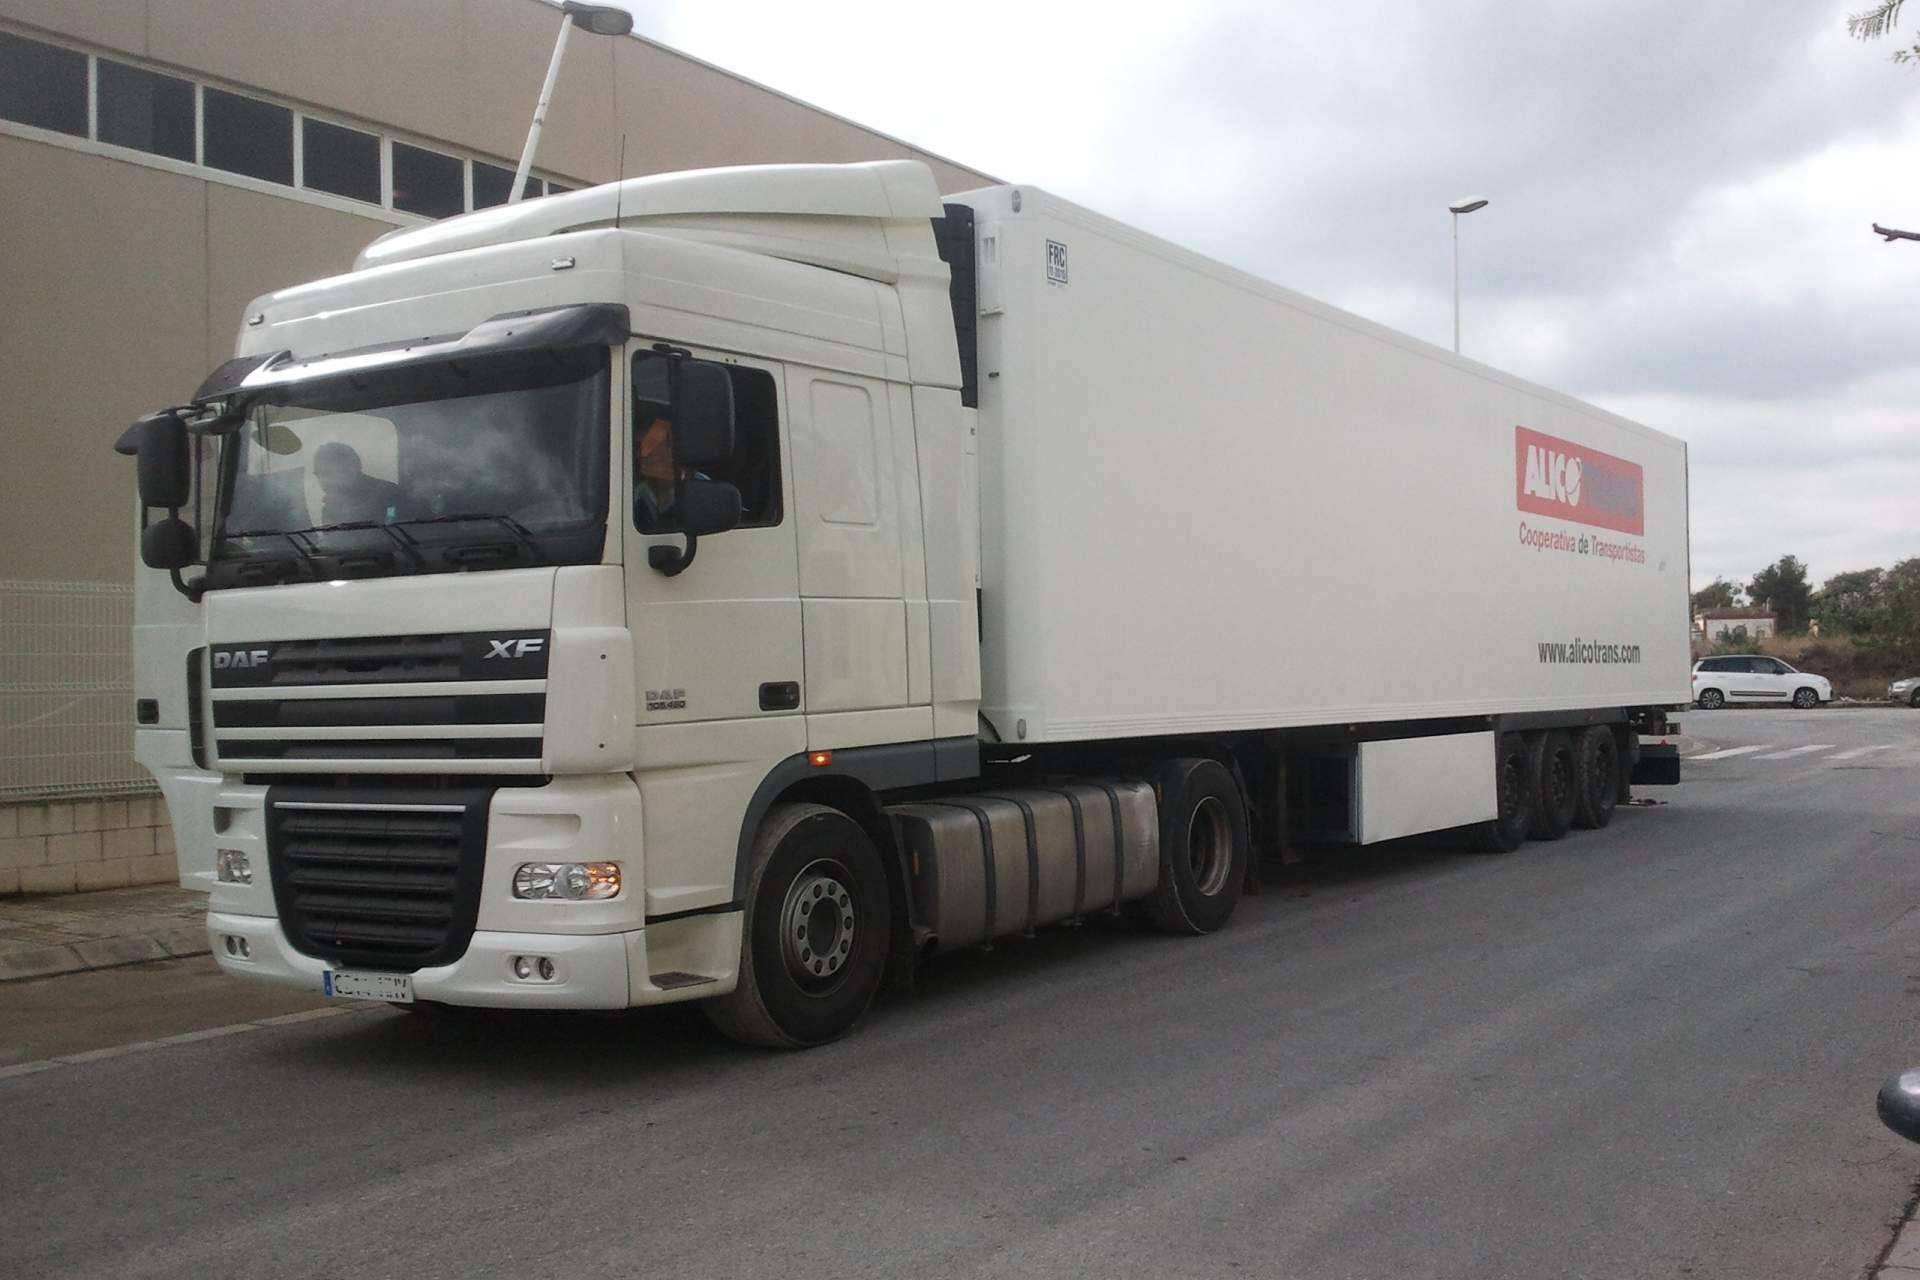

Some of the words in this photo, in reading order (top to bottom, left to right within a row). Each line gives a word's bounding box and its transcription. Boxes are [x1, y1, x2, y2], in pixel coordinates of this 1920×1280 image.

[1048, 243, 1065, 268] FRC
[1523, 444, 1582, 507] ALICO
[1519, 521, 1576, 554] Cooperativa
[1578, 533, 1589, 555] de
[1591, 535, 1646, 566] Transportistas
[213, 649, 270, 669] DAF
[482, 637, 544, 660] XF
[1538, 638, 1641, 664] www.alicotrans.com
